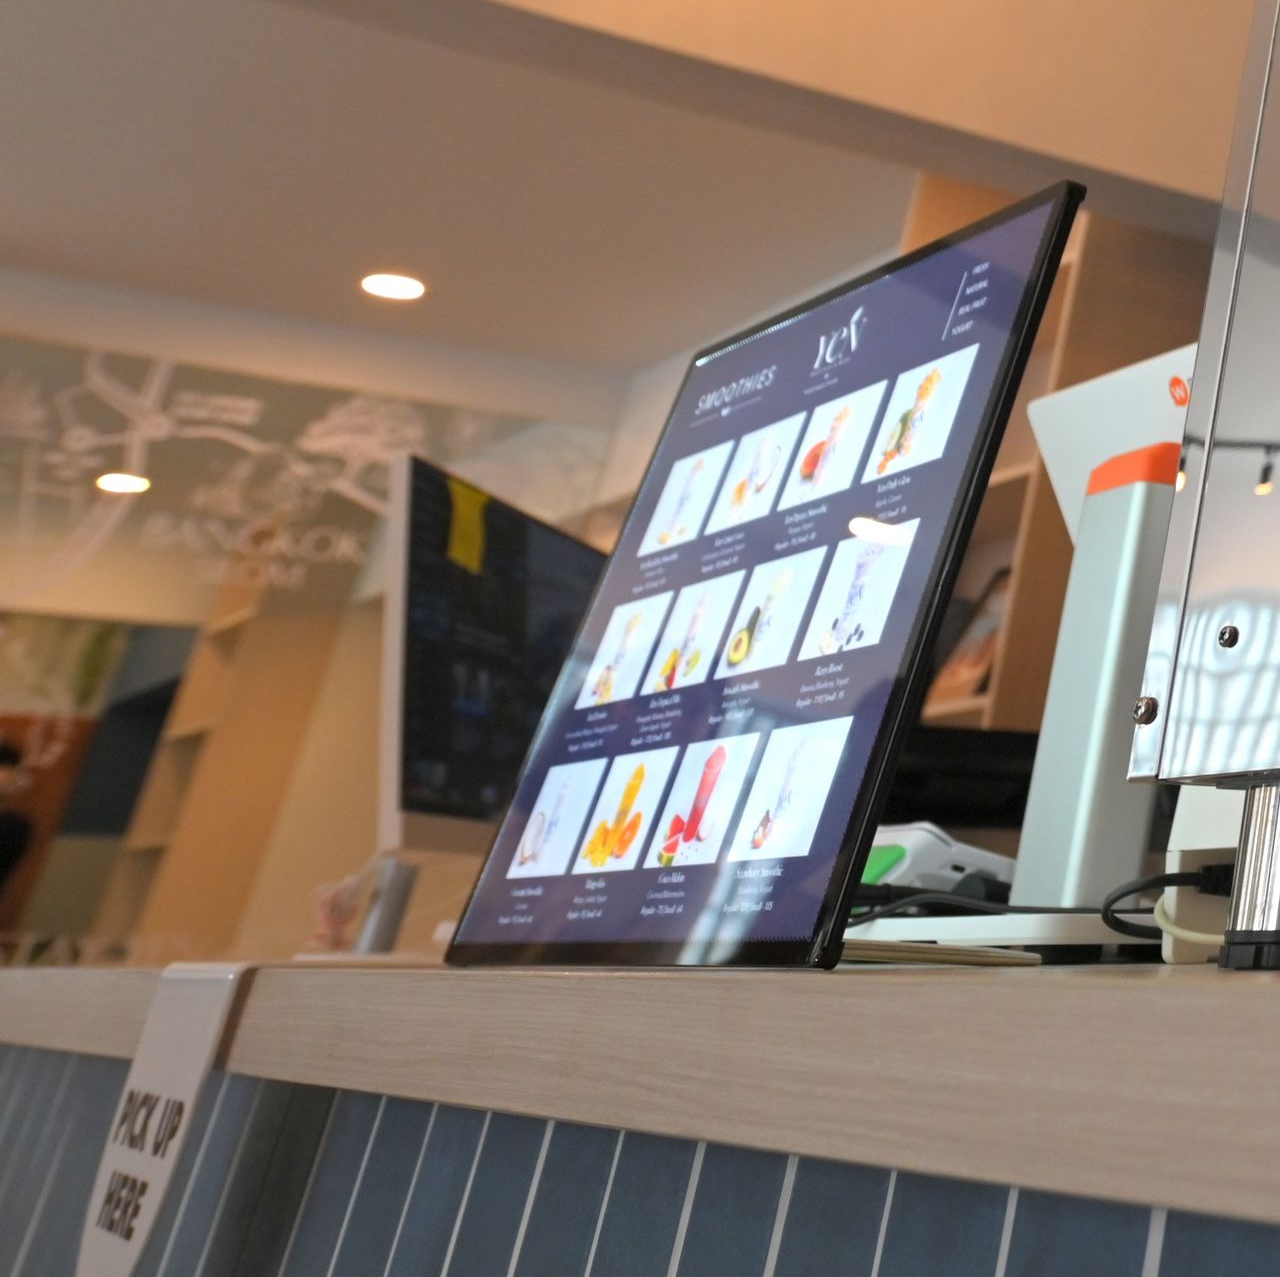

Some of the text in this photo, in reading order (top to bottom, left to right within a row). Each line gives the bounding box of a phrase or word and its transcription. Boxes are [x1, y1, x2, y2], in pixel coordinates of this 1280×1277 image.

[694, 365, 777, 415] SMOOTHIES
[112, 1090, 186, 1159] PICK UP
[95, 1170, 149, 1243] HERE
